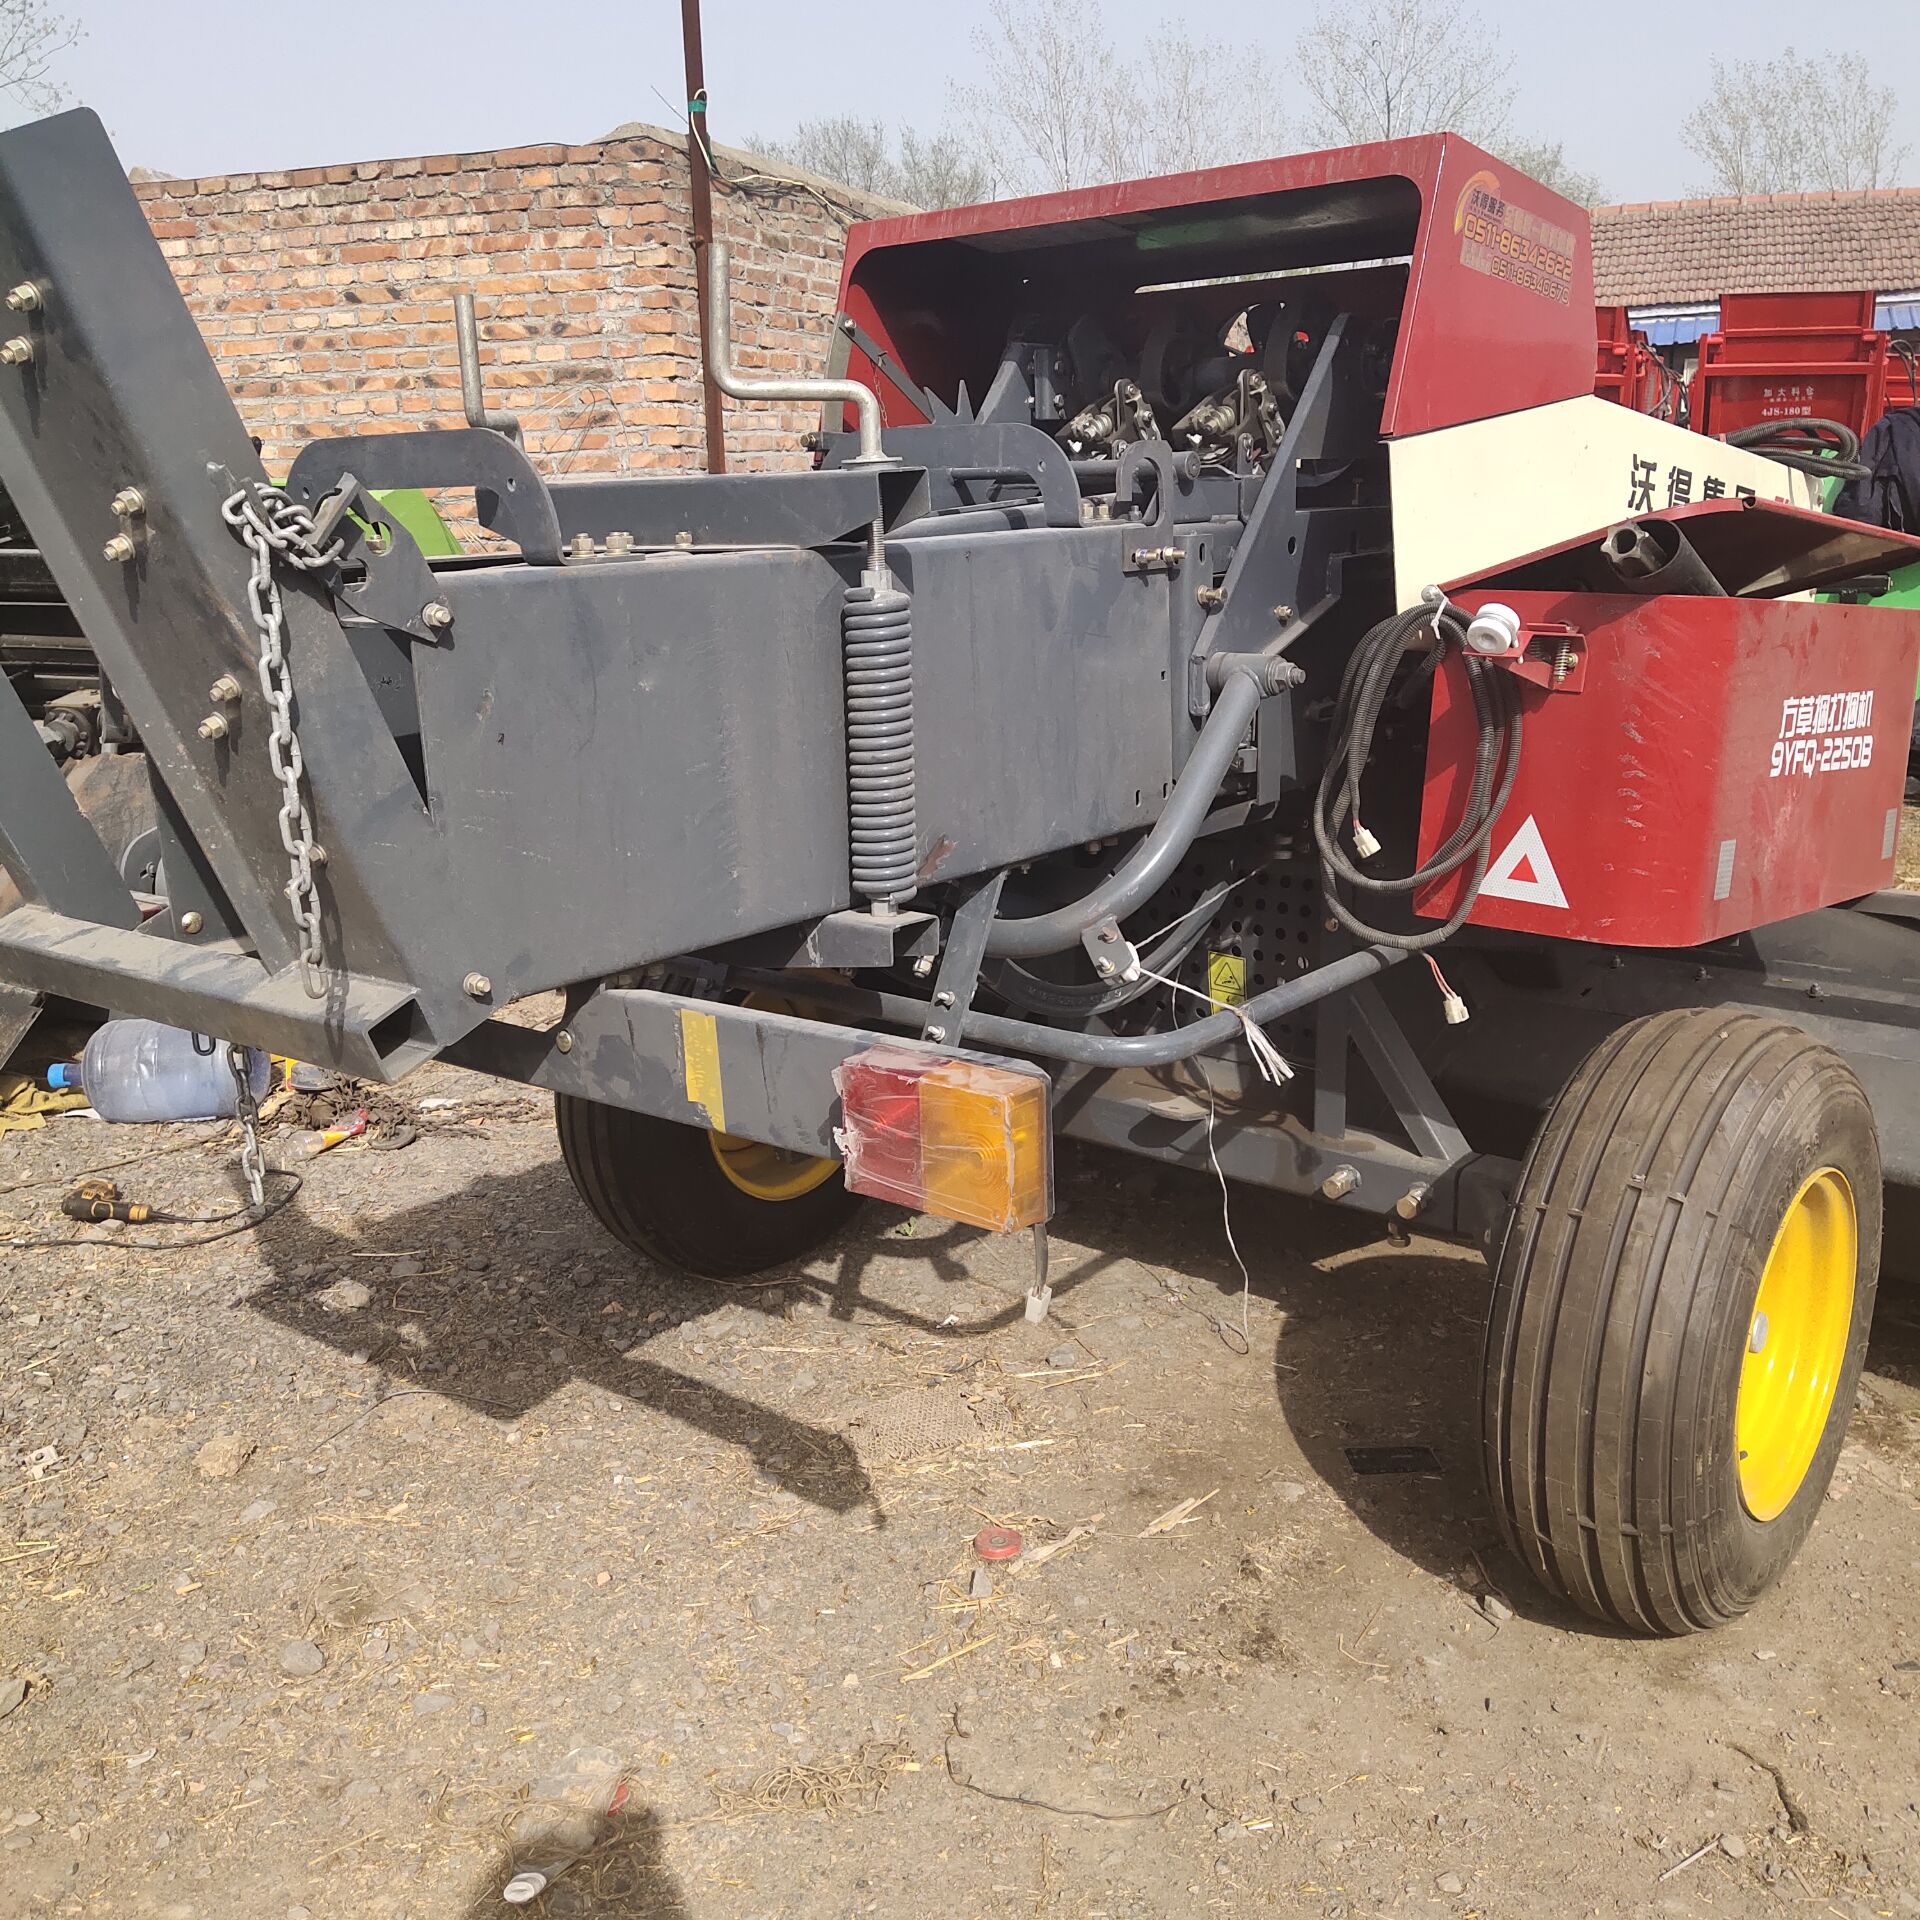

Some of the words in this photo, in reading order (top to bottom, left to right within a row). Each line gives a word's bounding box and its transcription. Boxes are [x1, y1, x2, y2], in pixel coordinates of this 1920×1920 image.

[1464, 213, 1574, 282] 0511-86342622
[1490, 255, 1570, 305] 0511-86340670
[1779, 690, 1874, 739] 方草捆打捆机
[1769, 735, 1873, 779] 9YFQ-2250B
